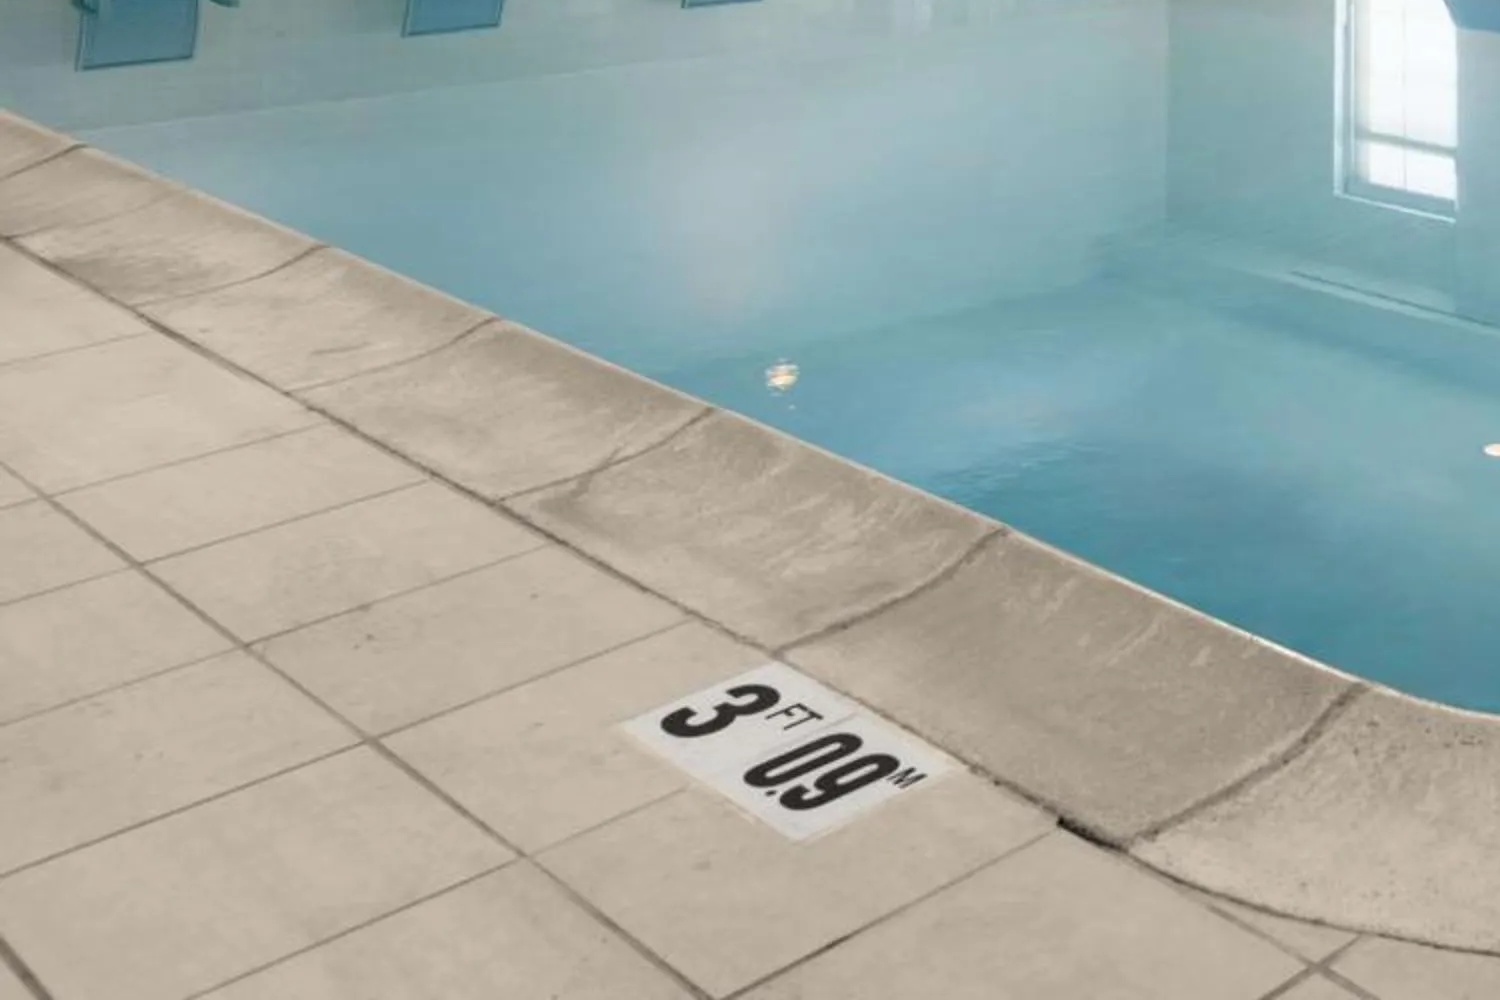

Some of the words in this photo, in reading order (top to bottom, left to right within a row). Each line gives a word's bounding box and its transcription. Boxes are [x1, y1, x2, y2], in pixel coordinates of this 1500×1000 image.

[660, 684, 781, 738] 3
[764, 703, 824, 731] FT
[743, 732, 901, 811] 0.9
[889, 767, 928, 789] M
